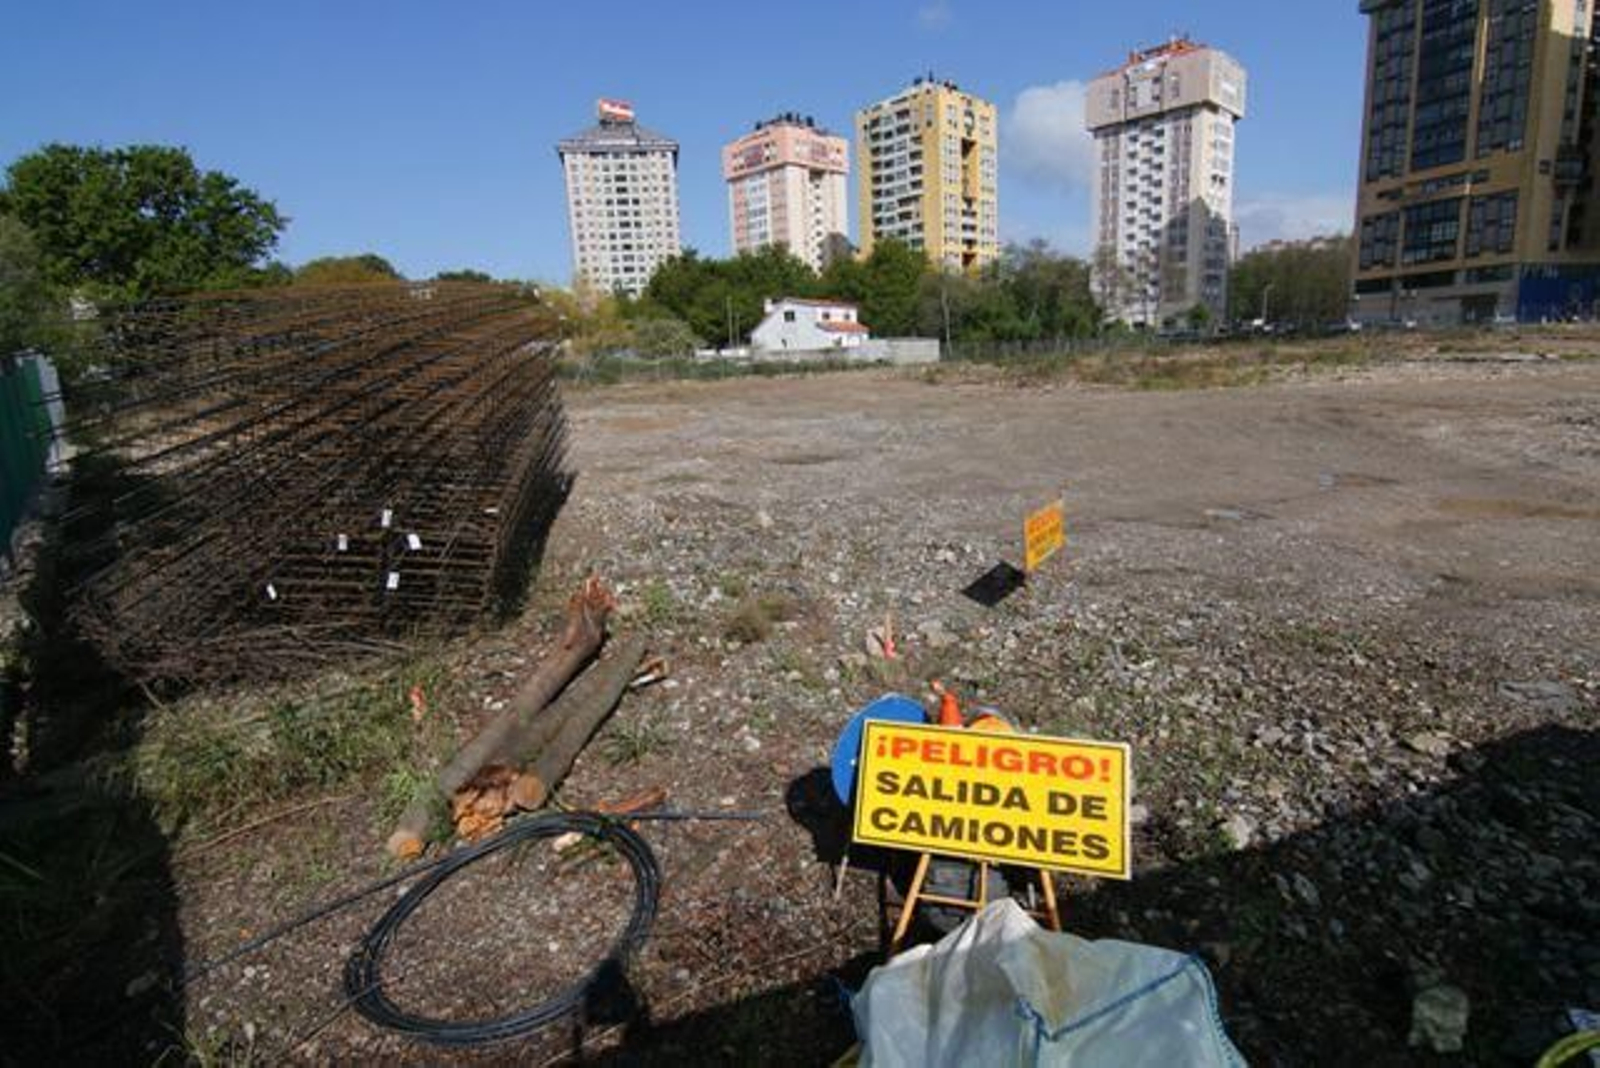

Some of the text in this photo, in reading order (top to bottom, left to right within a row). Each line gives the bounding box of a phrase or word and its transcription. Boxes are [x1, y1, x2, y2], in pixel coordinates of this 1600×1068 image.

[877, 735, 1111, 782] ¡PELIGRO!
[876, 771, 1109, 821] SALIDA DE
[870, 807, 1110, 860] CAMIONES
